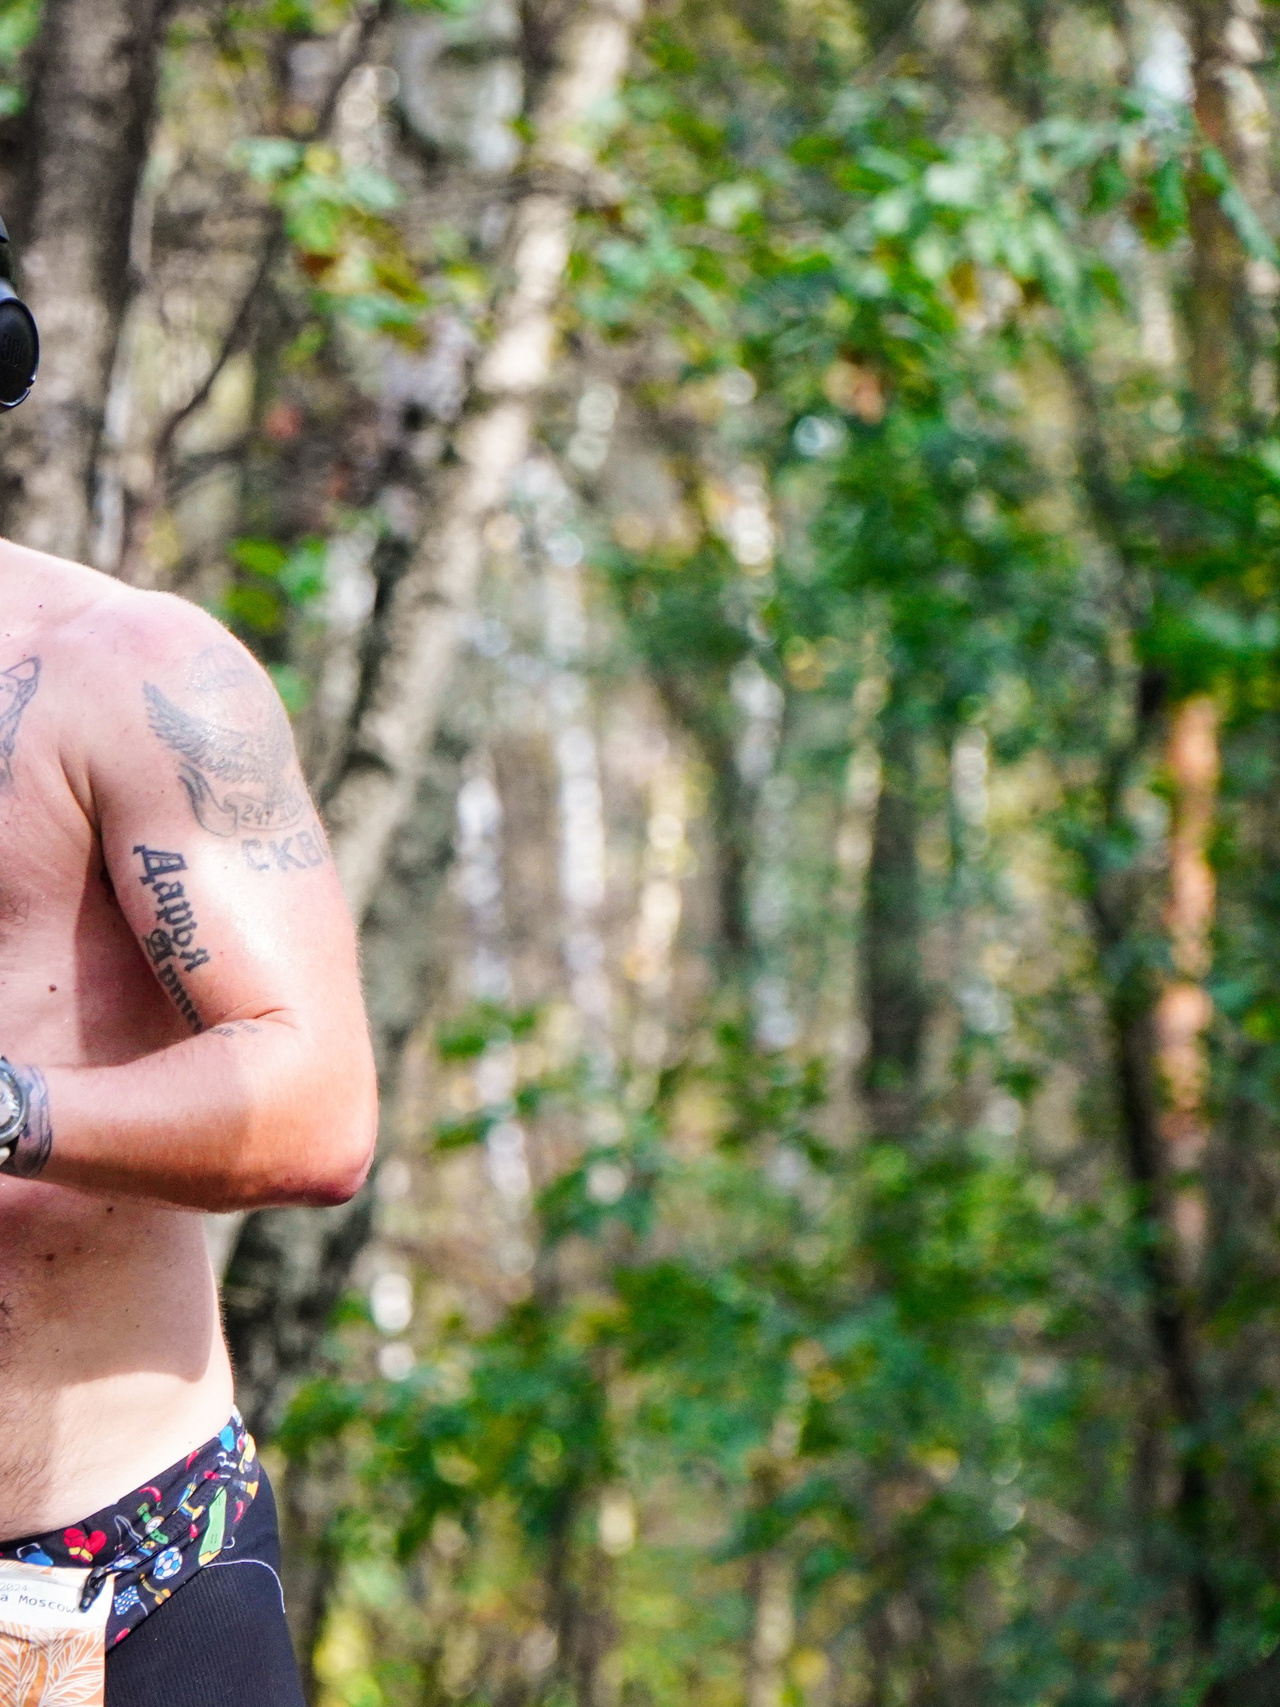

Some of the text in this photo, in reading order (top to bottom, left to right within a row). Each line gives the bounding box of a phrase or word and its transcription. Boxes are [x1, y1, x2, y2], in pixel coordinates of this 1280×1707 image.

[133, 845, 210, 973] Дарья
[0, 1582, 28, 1592] 2024
[18, 1594, 77, 1614] Moscow
